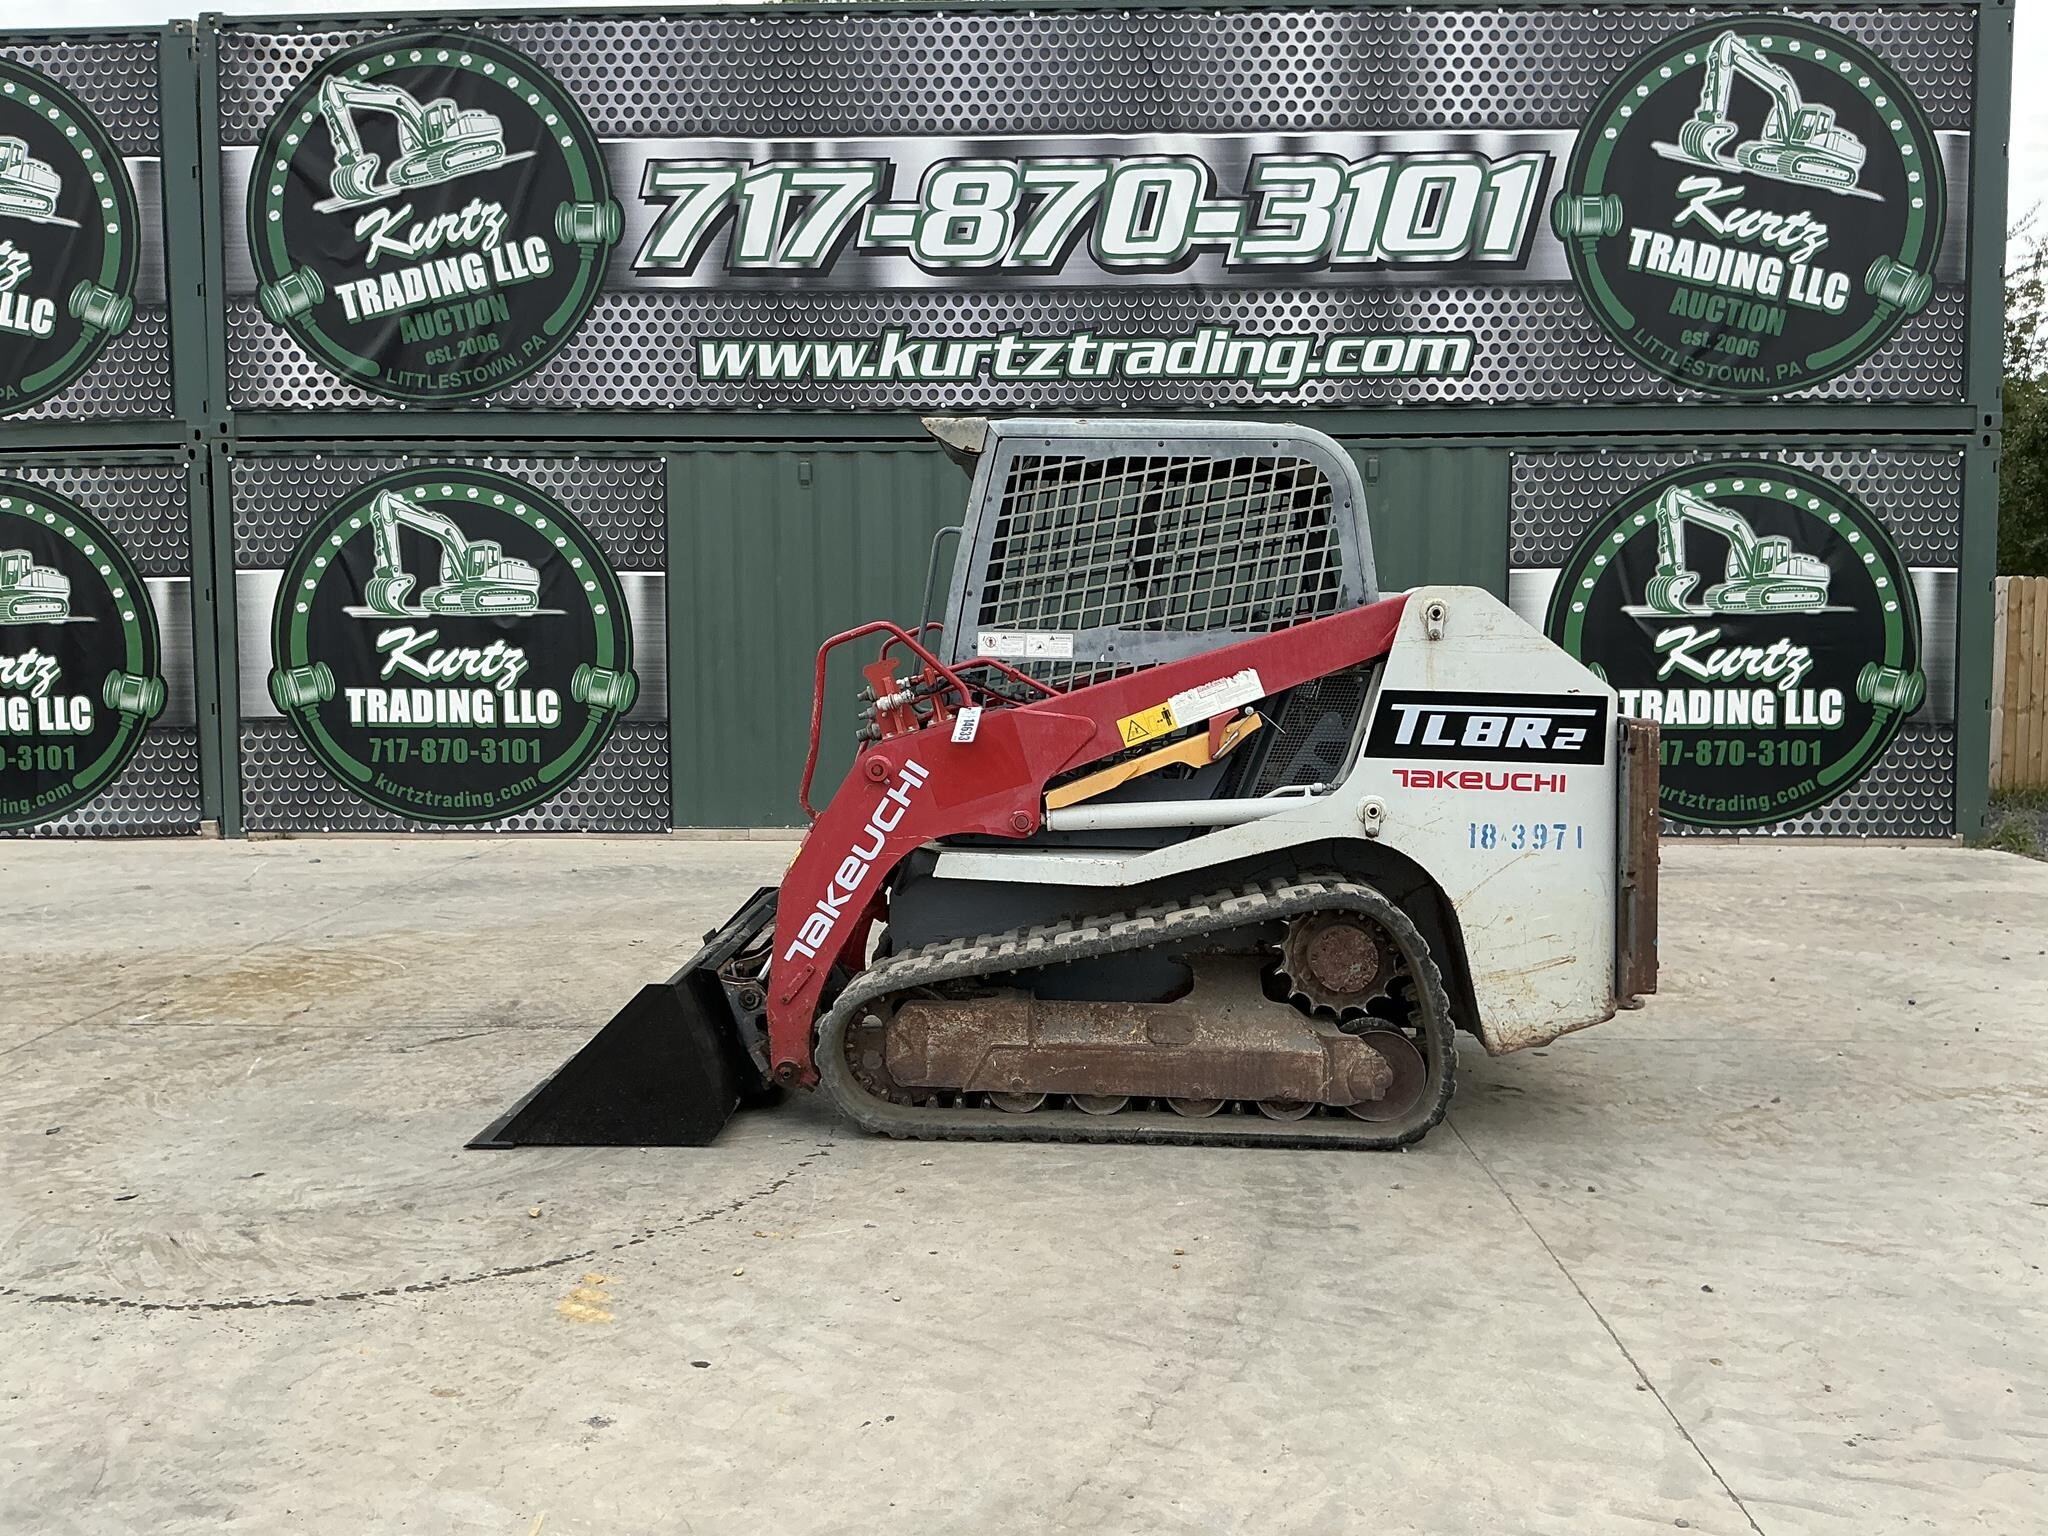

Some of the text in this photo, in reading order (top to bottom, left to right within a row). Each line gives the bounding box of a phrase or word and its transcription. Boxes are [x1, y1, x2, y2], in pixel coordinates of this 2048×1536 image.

[355, 198, 509, 266] Kurtz
[638, 155, 1548, 268] 717-870-3101
[1673, 175, 1829, 264] Kurtz
[334, 236, 552, 323] TRADING LLC
[1628, 228, 1850, 314] TRADING LLC
[0, 291, 56, 337] LLC
[400, 294, 510, 344] AUCTION
[1668, 288, 1787, 337] AUCTION
[386, 334, 547, 389] LITTLESTOWN, PA
[425, 333, 500, 366] est. 2006
[699, 327, 1474, 389] www.kurtztrading.com
[1633, 327, 1802, 384] LITTLESTOWN, PA
[1680, 328, 1760, 359] est. 2006
[376, 626, 528, 691] Kurtz
[1654, 626, 1813, 693] Kurtz
[38, 696, 93, 734] LLC
[345, 688, 561, 728] TRADING LLC
[1619, 688, 1845, 729] TRADING LLC
[369, 738, 540, 764] 717-870-3101
[1659, 740, 1821, 766] 17-870-3101
[374, 772, 538, 808] kurtztrading.com
[1659, 779, 1817, 812] urtztrading.com
